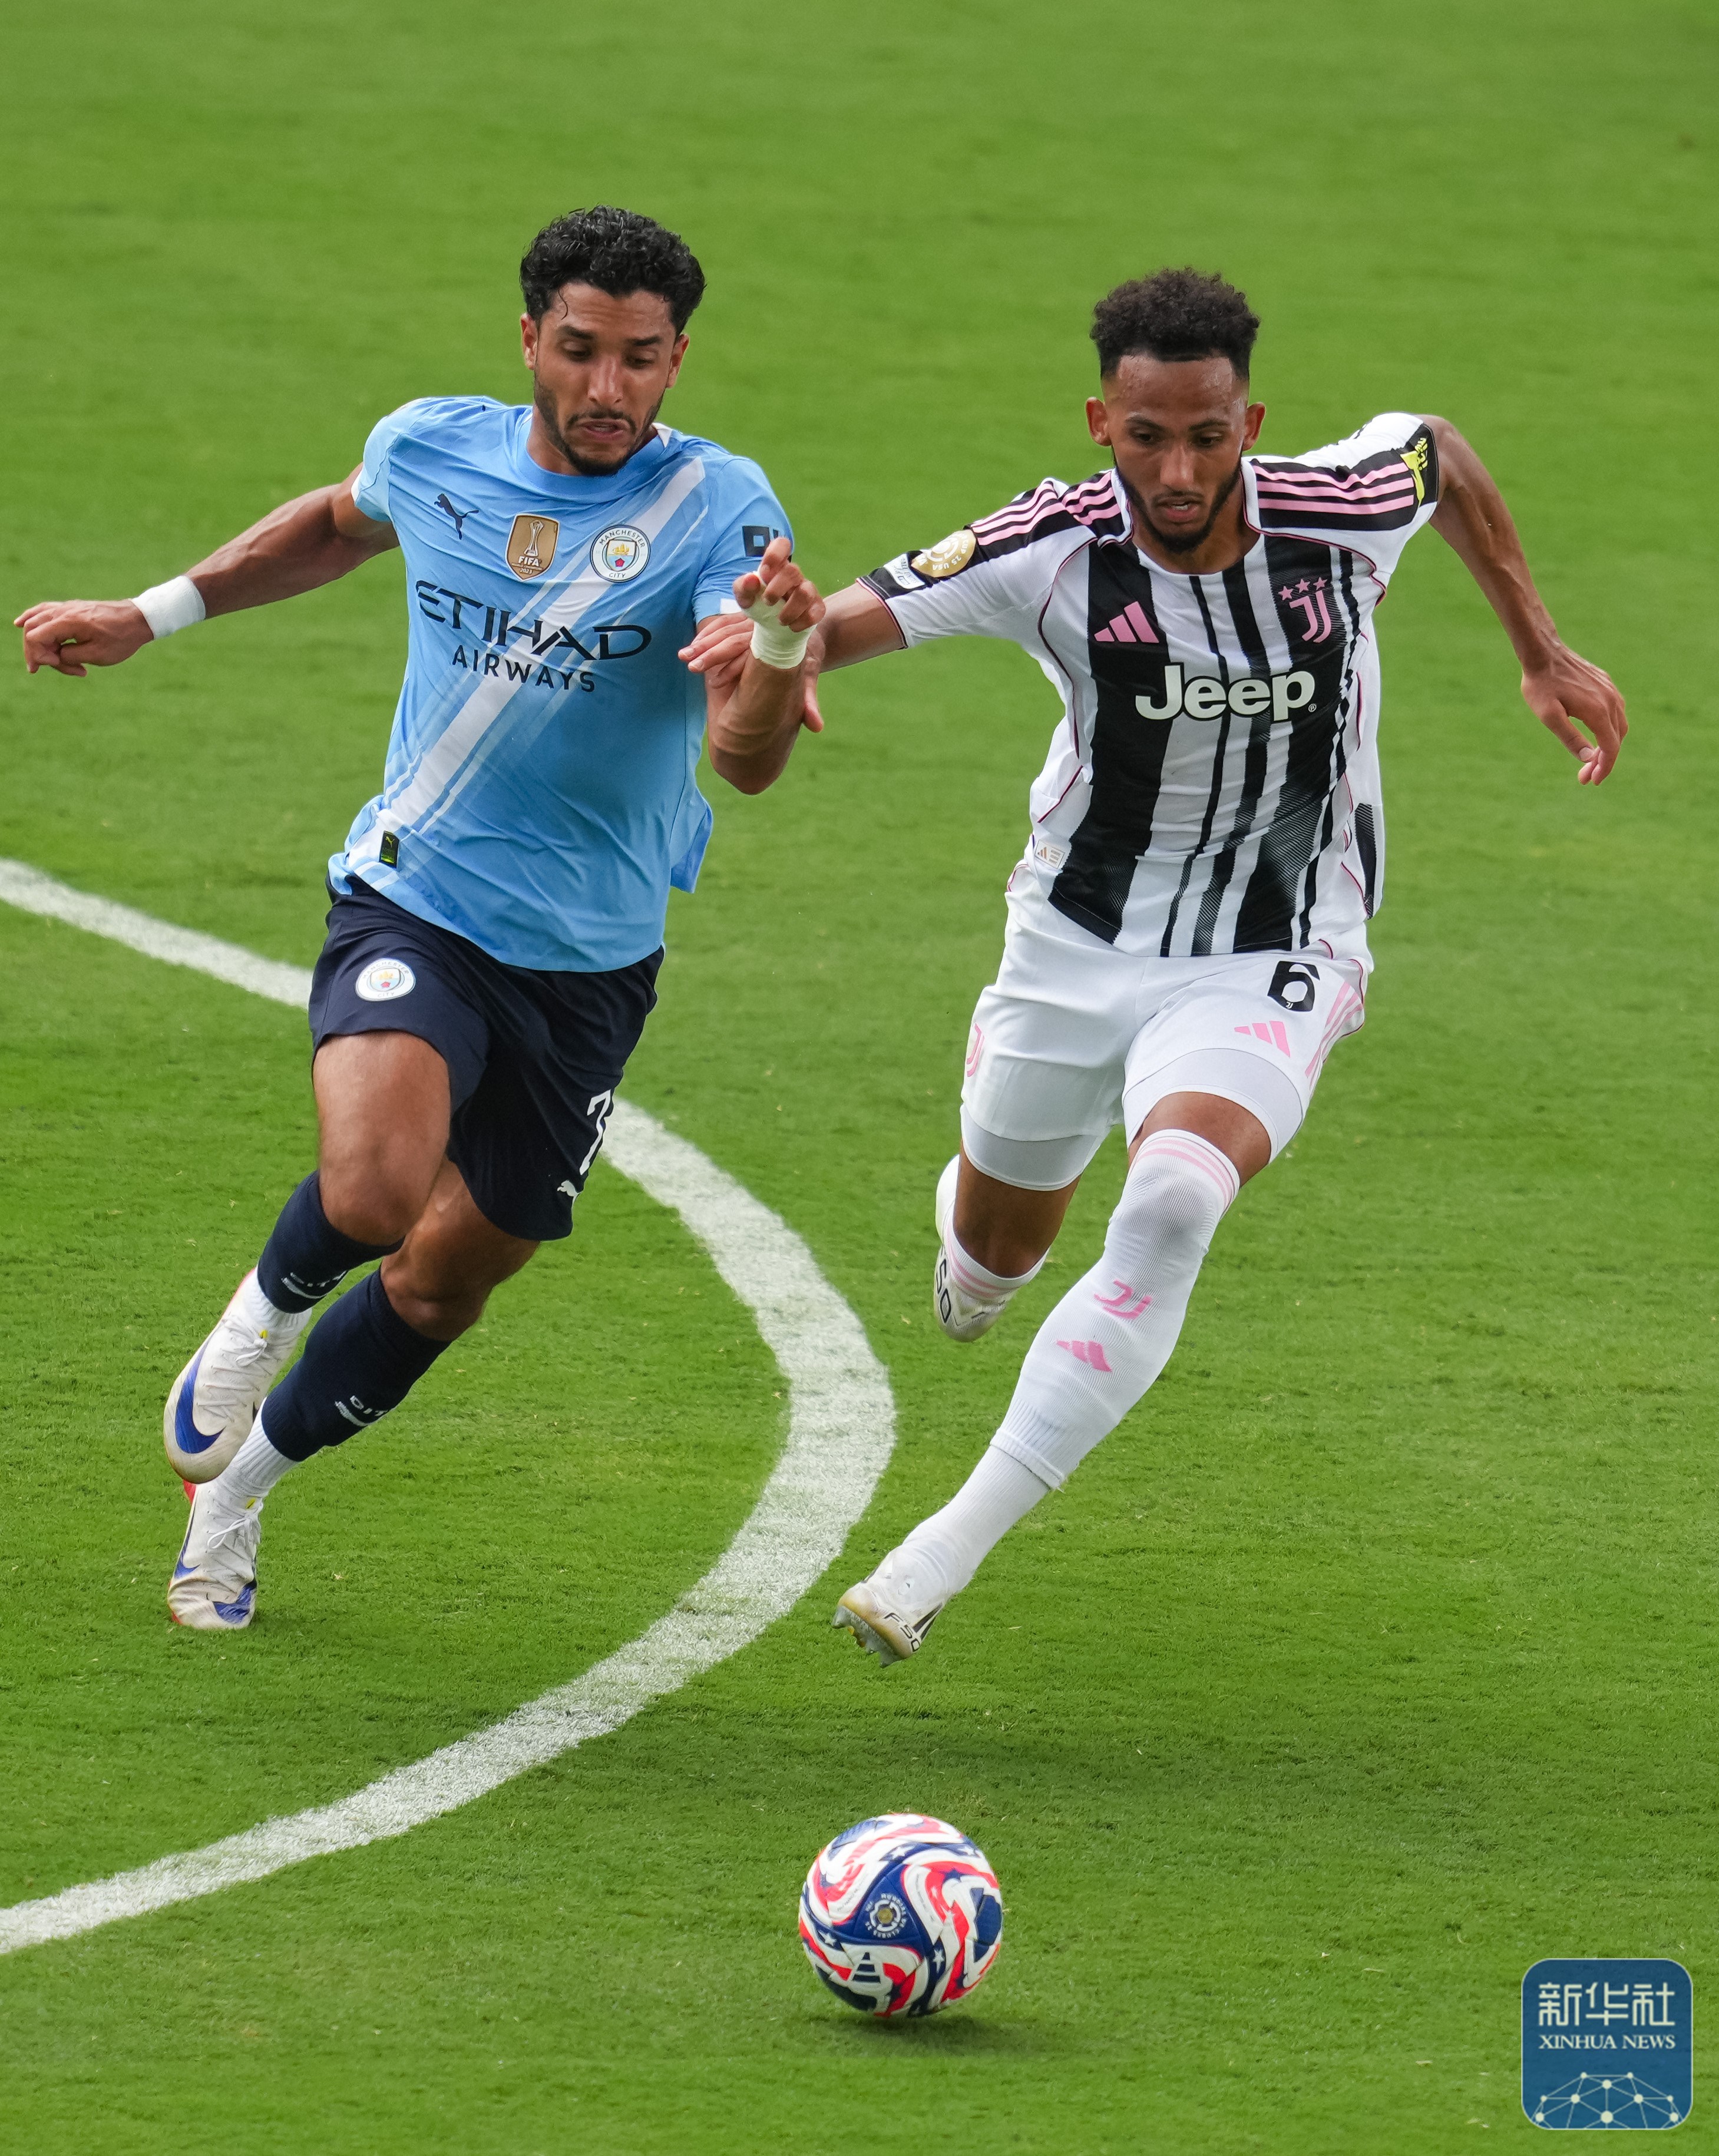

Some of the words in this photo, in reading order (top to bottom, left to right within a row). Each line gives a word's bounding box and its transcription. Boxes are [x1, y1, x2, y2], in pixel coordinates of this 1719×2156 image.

[518, 555, 539, 566] FIFA
[599, 530, 645, 548] MANCHESTER
[932, 563, 950, 571] USA
[415, 580, 652, 660] ETIHAD
[452, 644, 596, 692] AIRWAYS
[1135, 664, 1315, 722] Jeep
[1267, 960, 1320, 1012] 6
[579, 1089, 611, 1175] 7
[884, 1612, 921, 1652] F50
